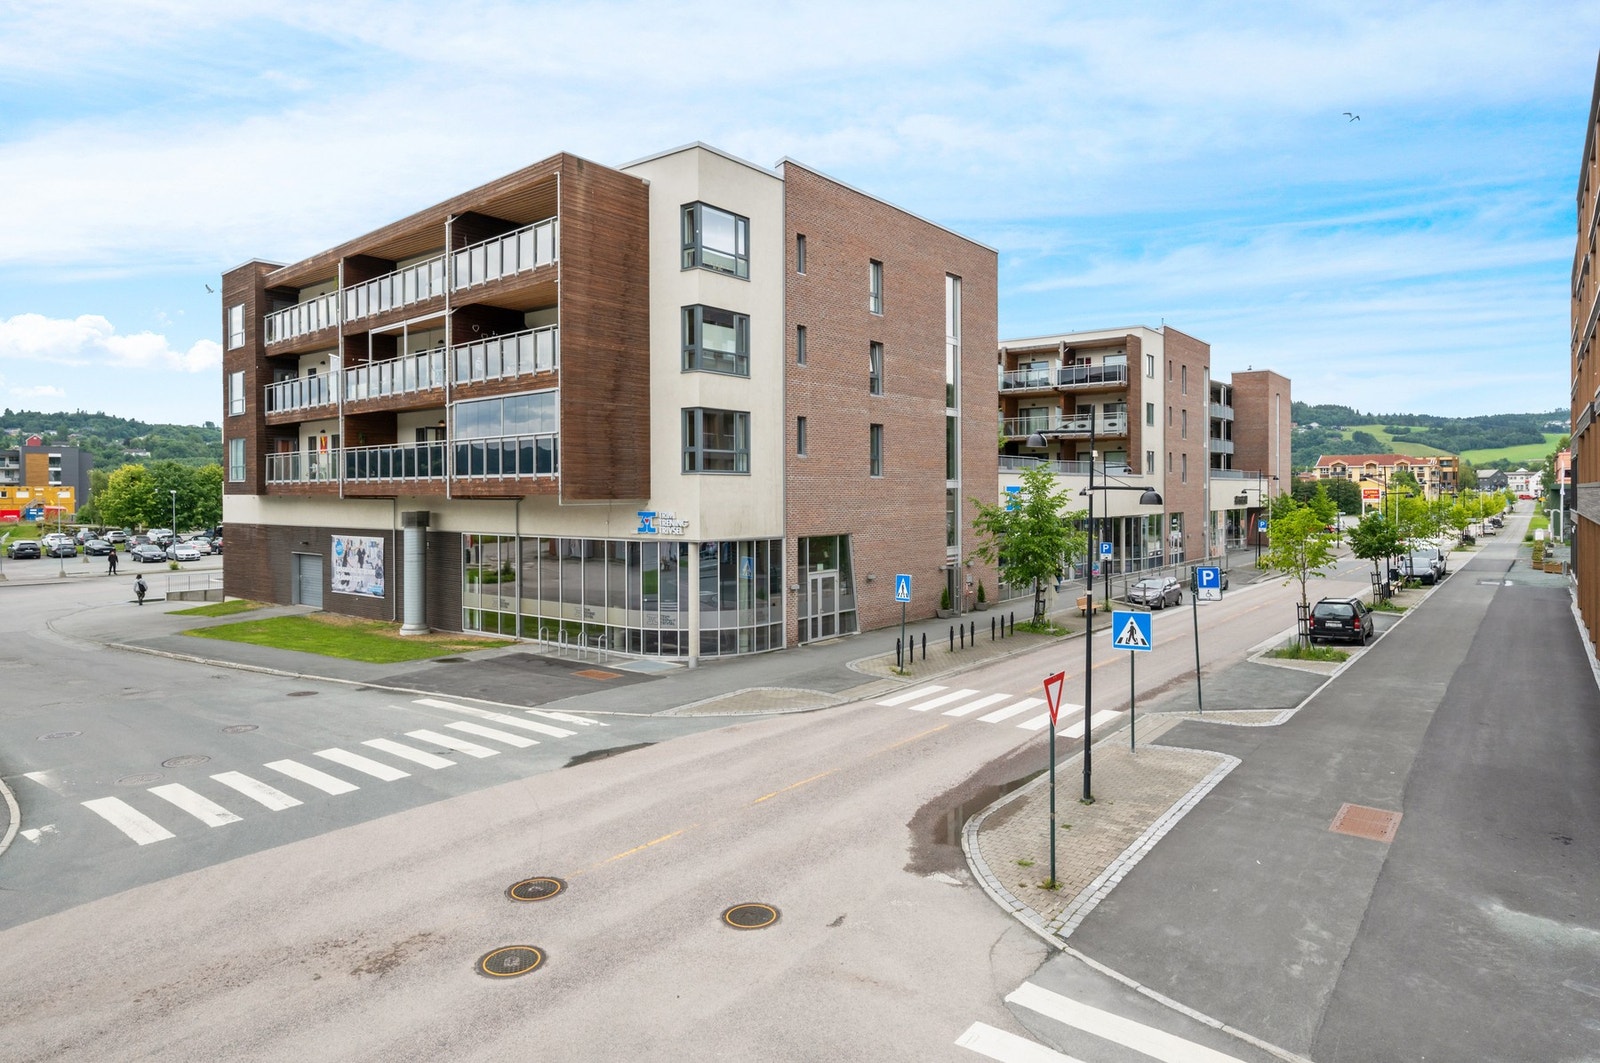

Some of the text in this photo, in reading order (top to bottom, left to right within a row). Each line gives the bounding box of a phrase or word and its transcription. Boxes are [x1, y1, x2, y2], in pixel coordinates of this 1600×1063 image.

[658, 519, 689, 527] TRENING
[659, 527, 685, 535] TRIVSEL
[1102, 544, 1109, 553] P
[1202, 570, 1214, 586] P
